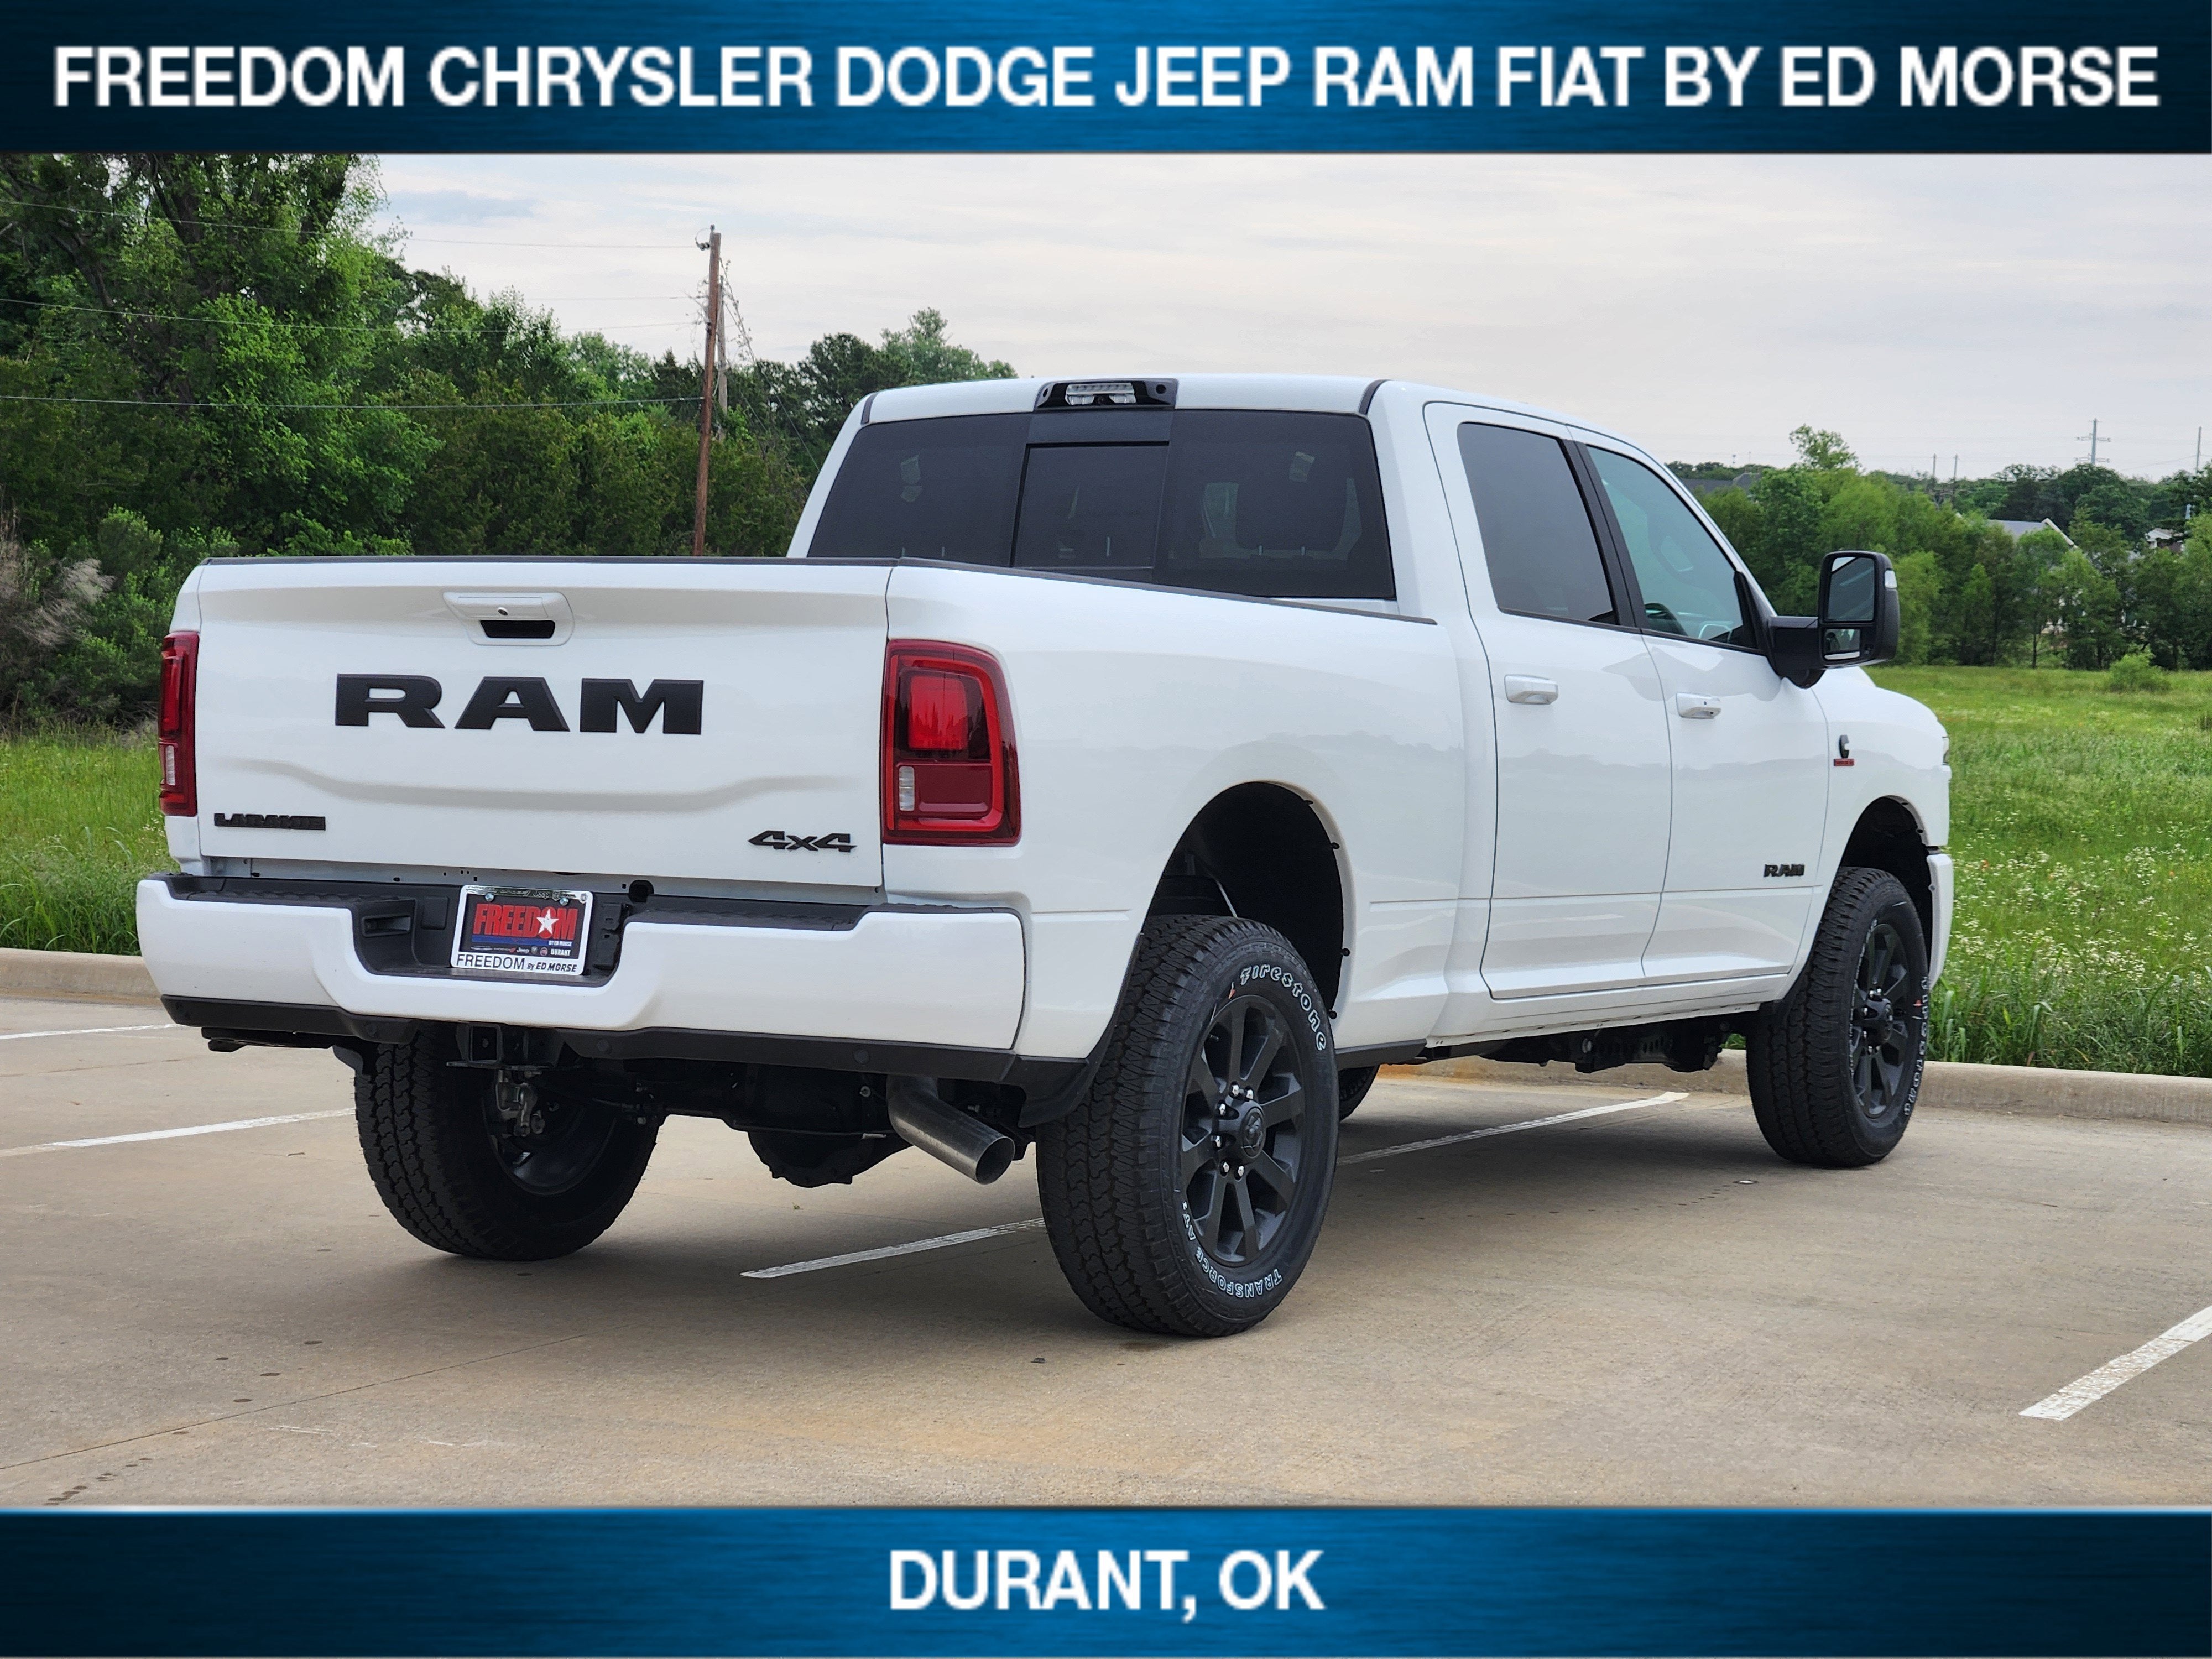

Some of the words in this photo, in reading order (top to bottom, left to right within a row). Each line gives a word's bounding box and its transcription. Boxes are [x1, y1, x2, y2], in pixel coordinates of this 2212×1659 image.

[335, 673, 703, 735] RAM
[1764, 864, 1804, 877] RAM
[473, 903, 578, 940] FREEDOM
[457, 954, 525, 970] FREEDOM
[535, 962, 547, 971] ED
[547, 963, 578, 972] MORSE
[1196, 1246, 1282, 1298] TRANSFORCE
